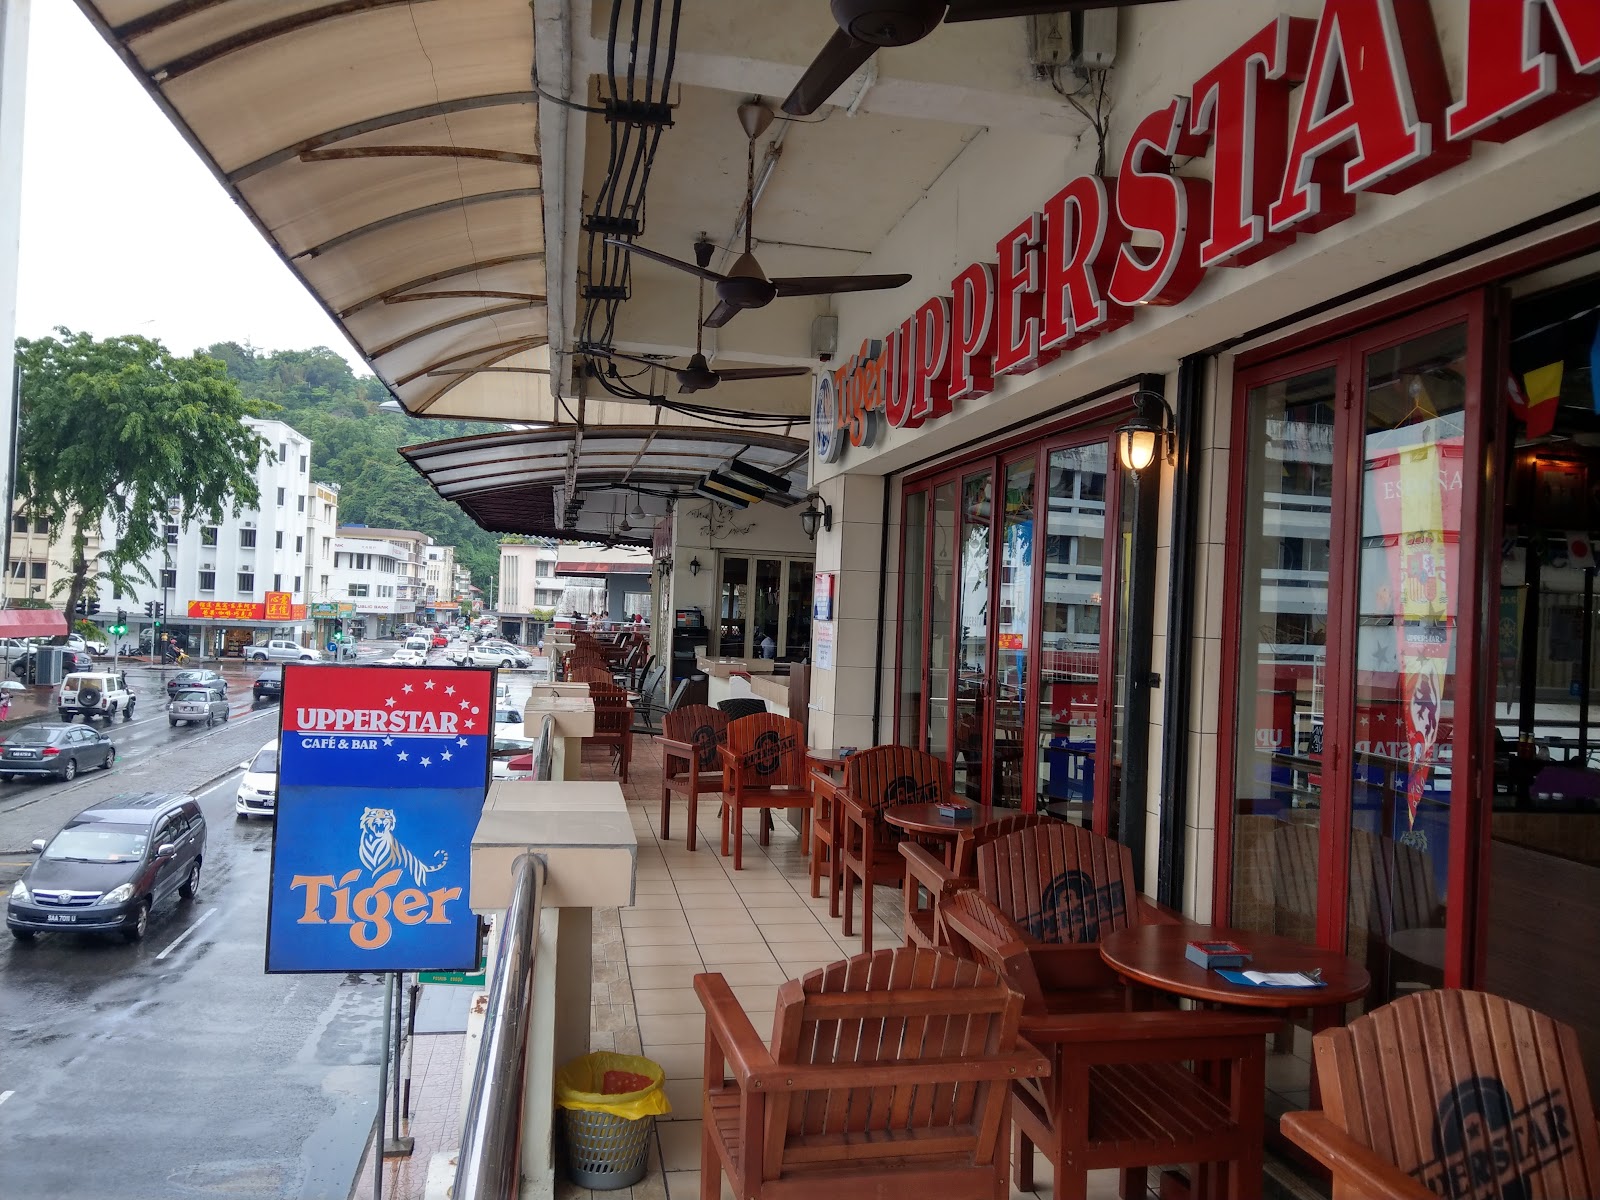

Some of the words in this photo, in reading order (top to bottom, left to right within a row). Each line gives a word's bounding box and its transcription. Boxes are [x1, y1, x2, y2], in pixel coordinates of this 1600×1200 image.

[834, 338, 887, 447] Tiger
[1383, 470, 1463, 500] ESÑA
[296, 707, 459, 733] UPPERSTAR
[301, 736, 336, 750] CAFÉ
[337, 738, 349, 750] &
[351, 739, 378, 750] BAR
[289, 868, 462, 950] Tiger
